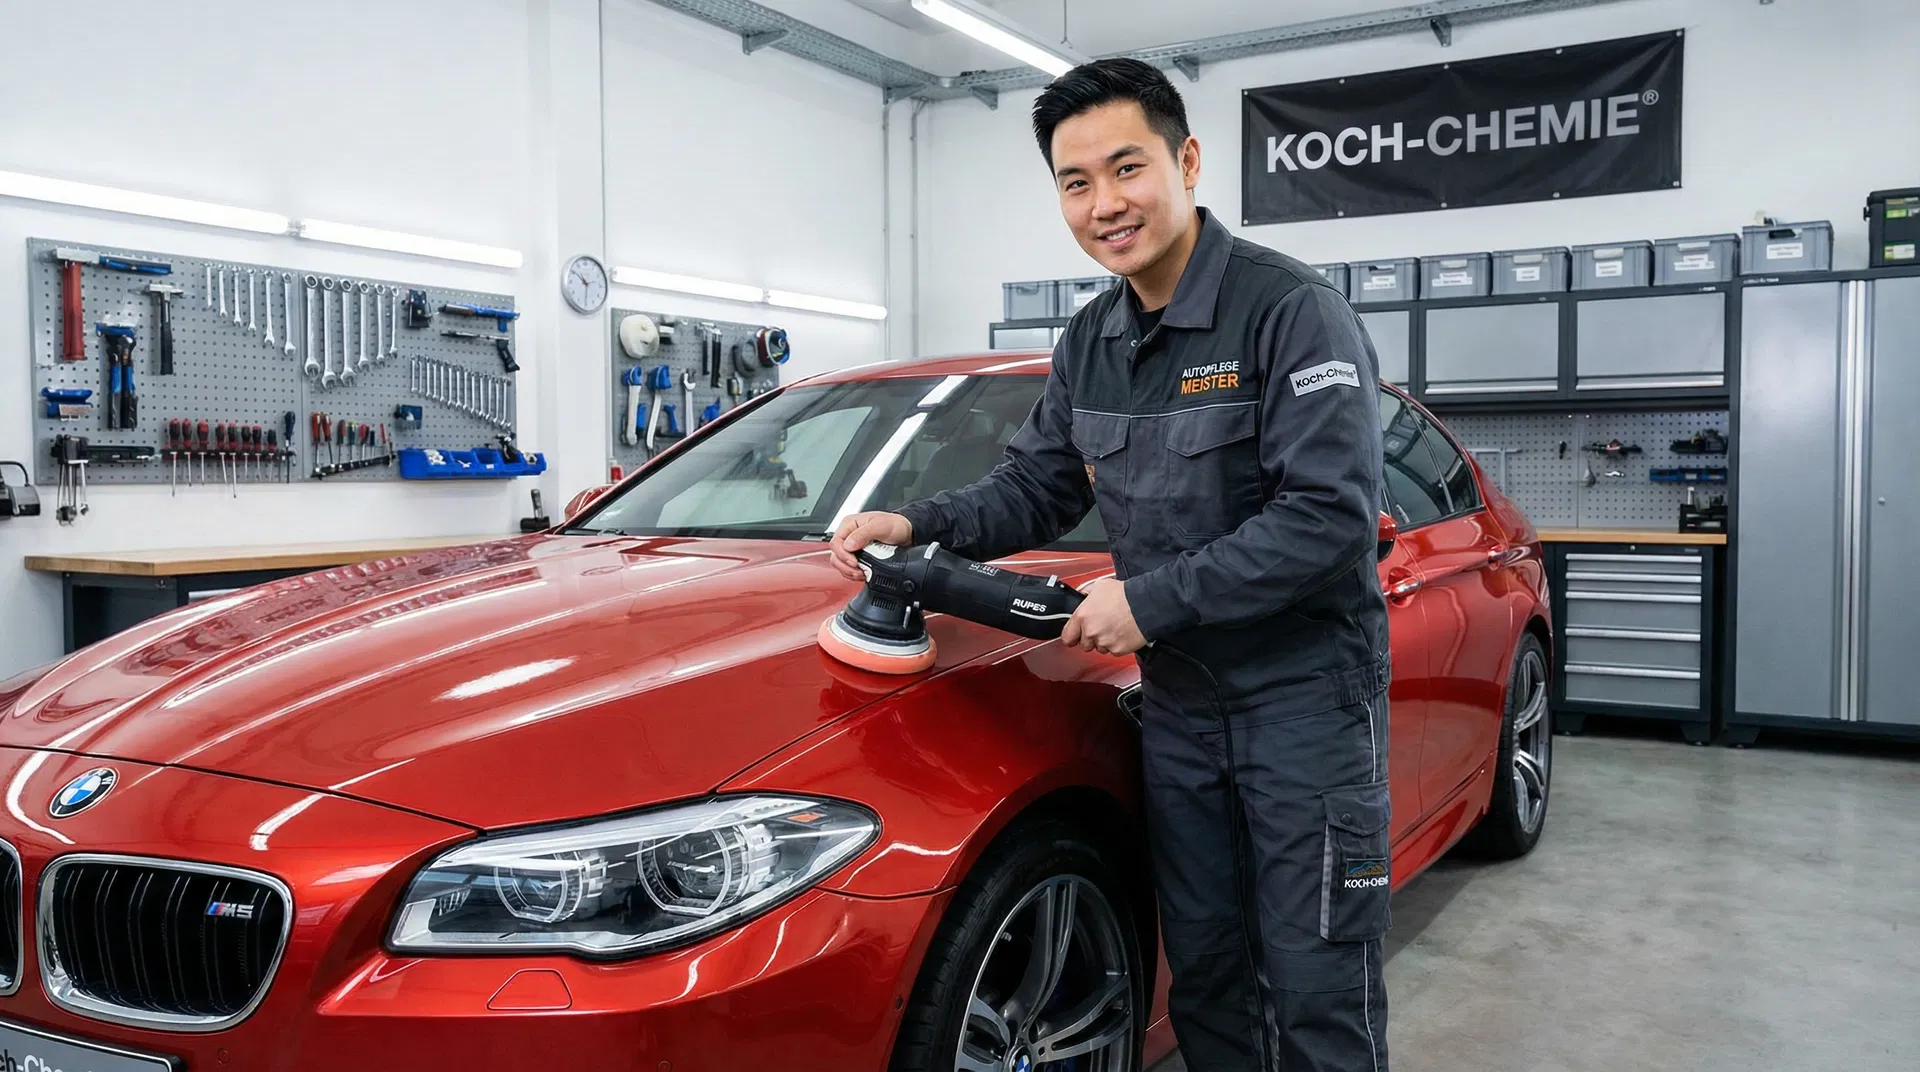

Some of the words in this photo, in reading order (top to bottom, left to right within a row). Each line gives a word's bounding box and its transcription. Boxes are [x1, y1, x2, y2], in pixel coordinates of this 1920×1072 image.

[1181, 373, 1239, 395] MEISTER
[1012, 598, 1047, 613] RUPES
[219, 902, 254, 919] M5
